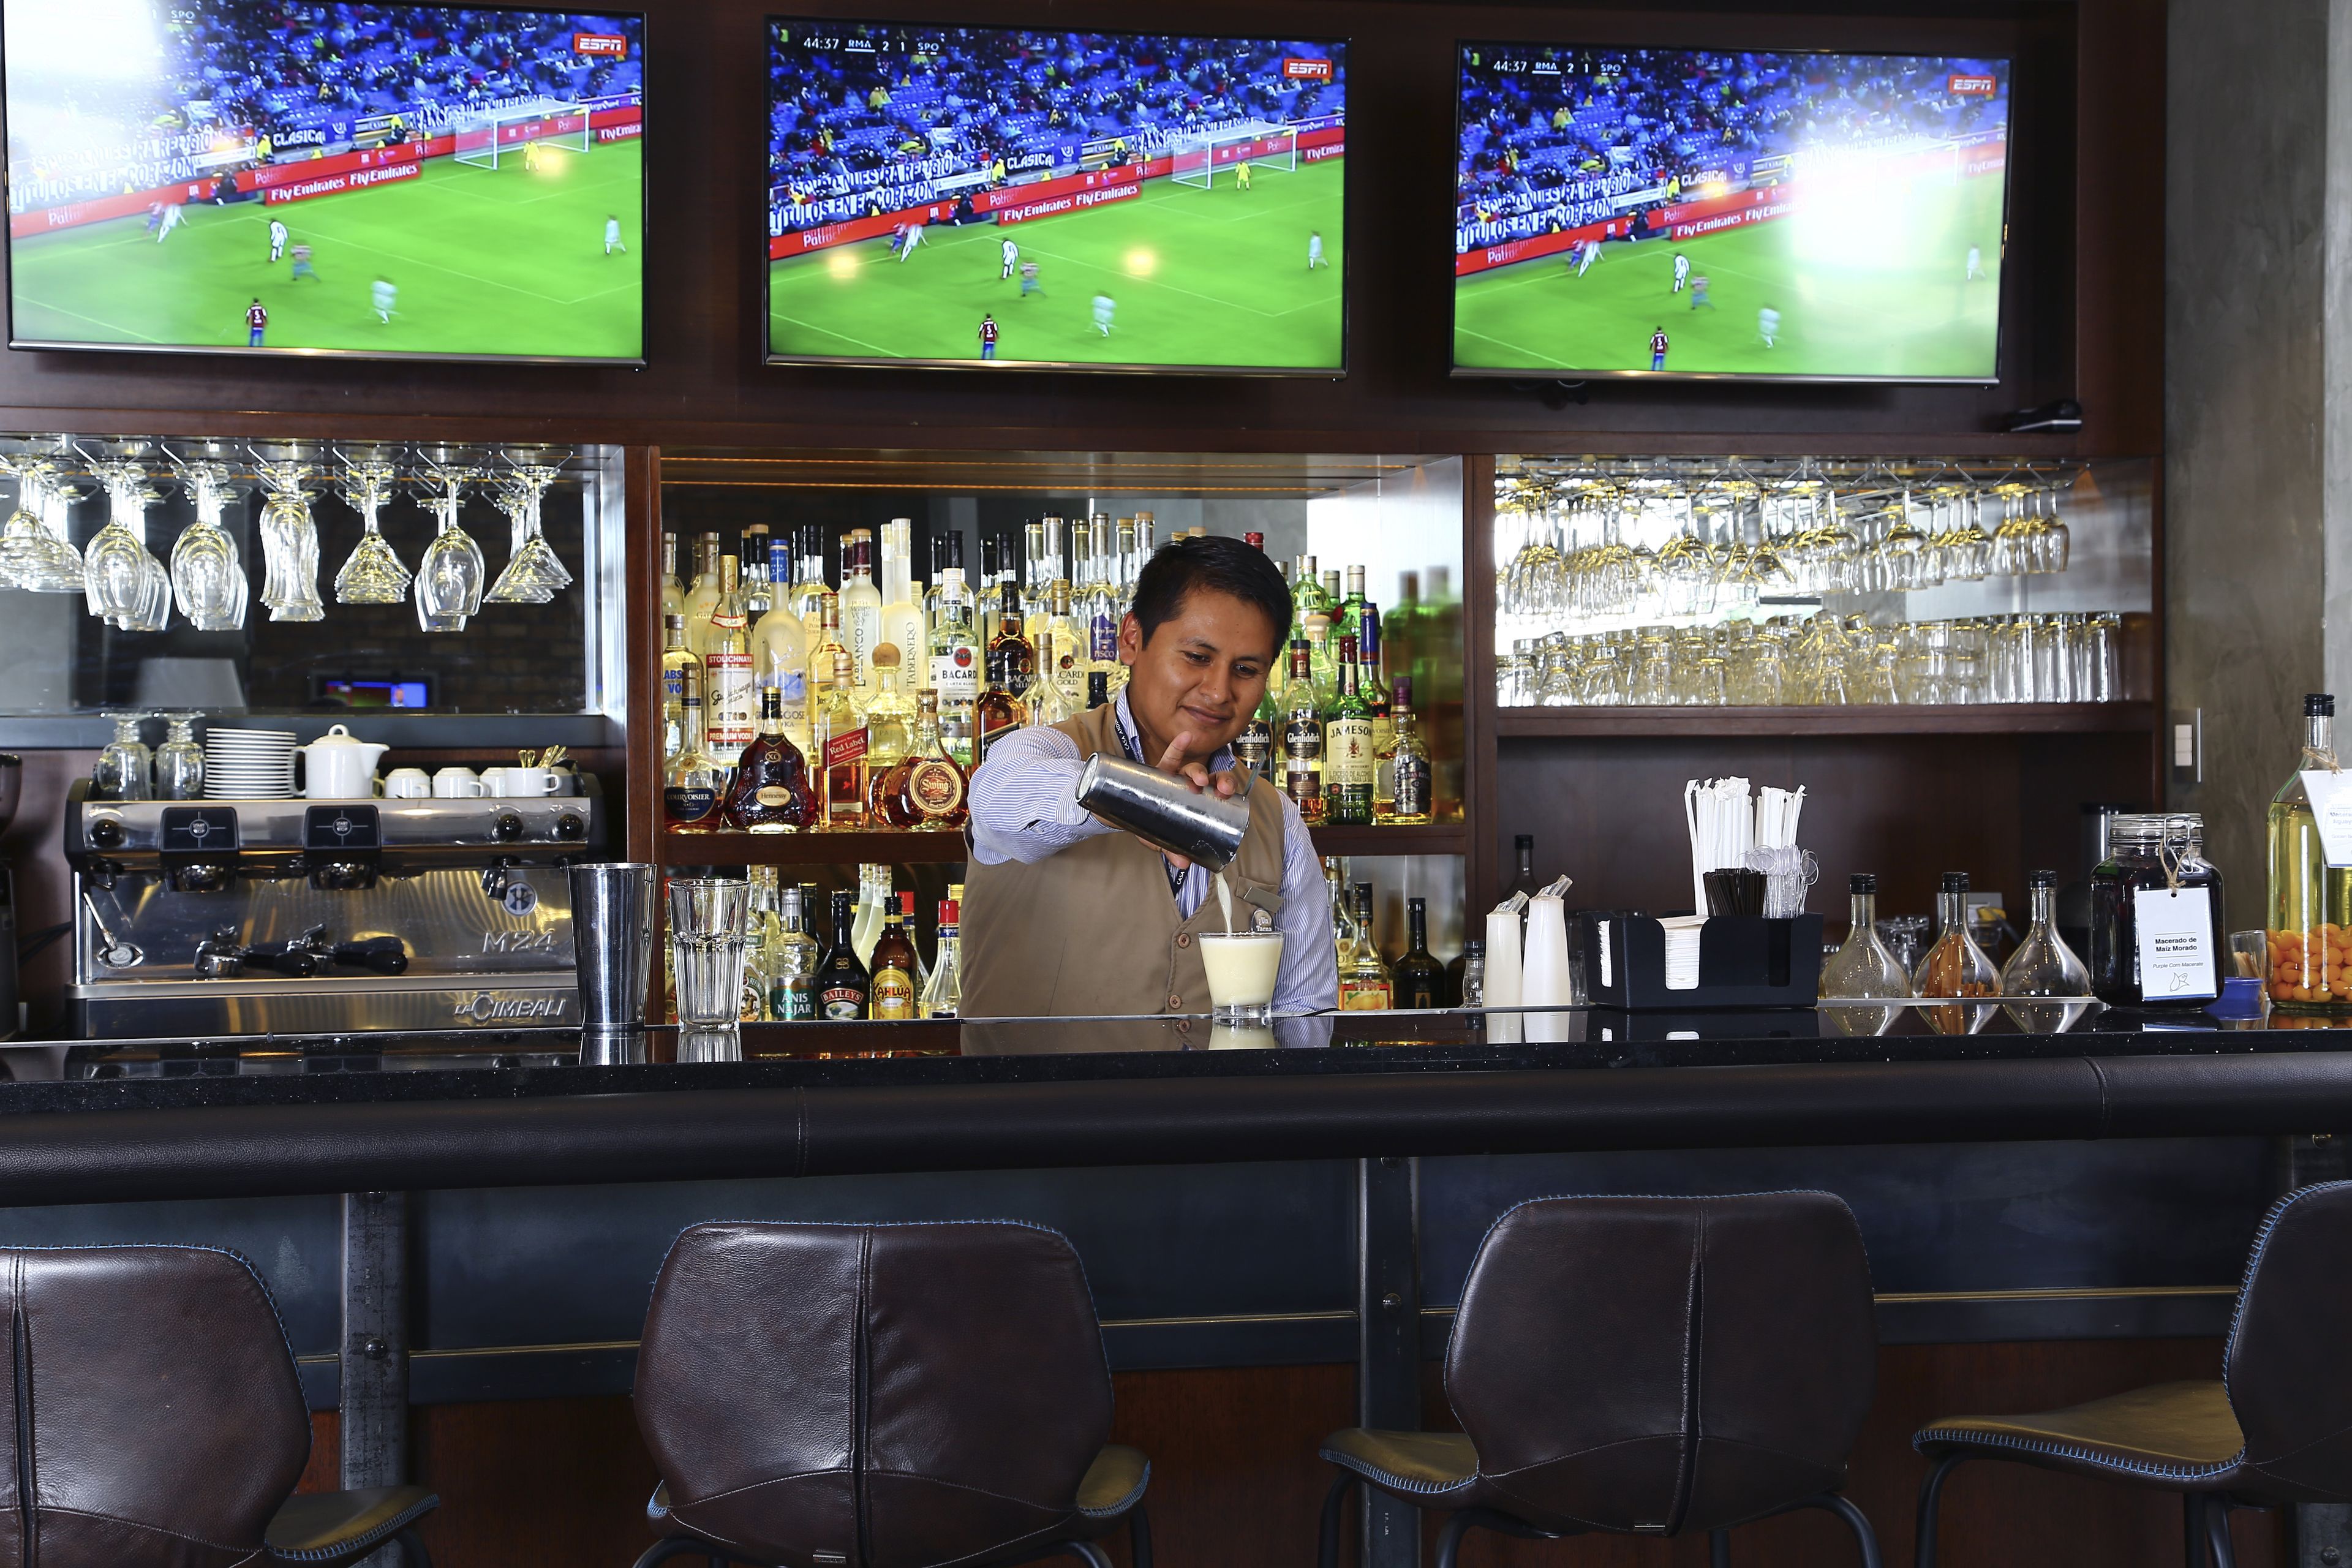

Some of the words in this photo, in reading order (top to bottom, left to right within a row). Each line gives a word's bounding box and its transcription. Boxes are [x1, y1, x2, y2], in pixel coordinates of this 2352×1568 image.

[171, 10, 195, 20] SPO
[579, 37, 622, 51] ESPN
[804, 37, 839, 50] 44:37
[848, 39, 872, 48] RMA
[883, 41, 889, 51] 2
[900, 41, 905, 51] 1
[918, 42, 939, 51] SPO
[1288, 62, 1329, 75] ESPN
[1493, 61, 1527, 72] 44:37
[1567, 62, 1574, 73] 2
[1585, 63, 1589, 73] 1
[1600, 64, 1621, 72] SPO
[1953, 79, 1992, 91] ESPN
[350, 172, 369, 186] Fly
[370, 164, 417, 183] Emirates
[271, 188, 293, 201] Fly
[293, 178, 345, 196] Emirates
[1076, 193, 1093, 207] Fly
[1094, 184, 1137, 203] Emirates
[1004, 208, 1023, 221] Fly
[1024, 197, 1071, 217] Emirates
[1746, 209, 1763, 221] Fly
[1677, 225, 1695, 237] Fly
[1697, 214, 1741, 232] Emirates
[943, 670, 976, 679] BACARD
[1287, 733, 1320, 743] Glenfiddich
[1330, 726, 1372, 738] JAMESON
[829, 744, 845, 755] Red
[845, 737, 864, 748] Label
[1121, 736, 1129, 750] CASA
[921, 779, 949, 793] Swing
[482, 928, 556, 953] M24
[782, 992, 808, 1004] ANIS
[823, 989, 862, 1000] BAILEYS
[872, 982, 911, 1002] KAHLÚA
[471, 995, 567, 1022] CIMBALI
[777, 1004, 811, 1015] NAJAR
